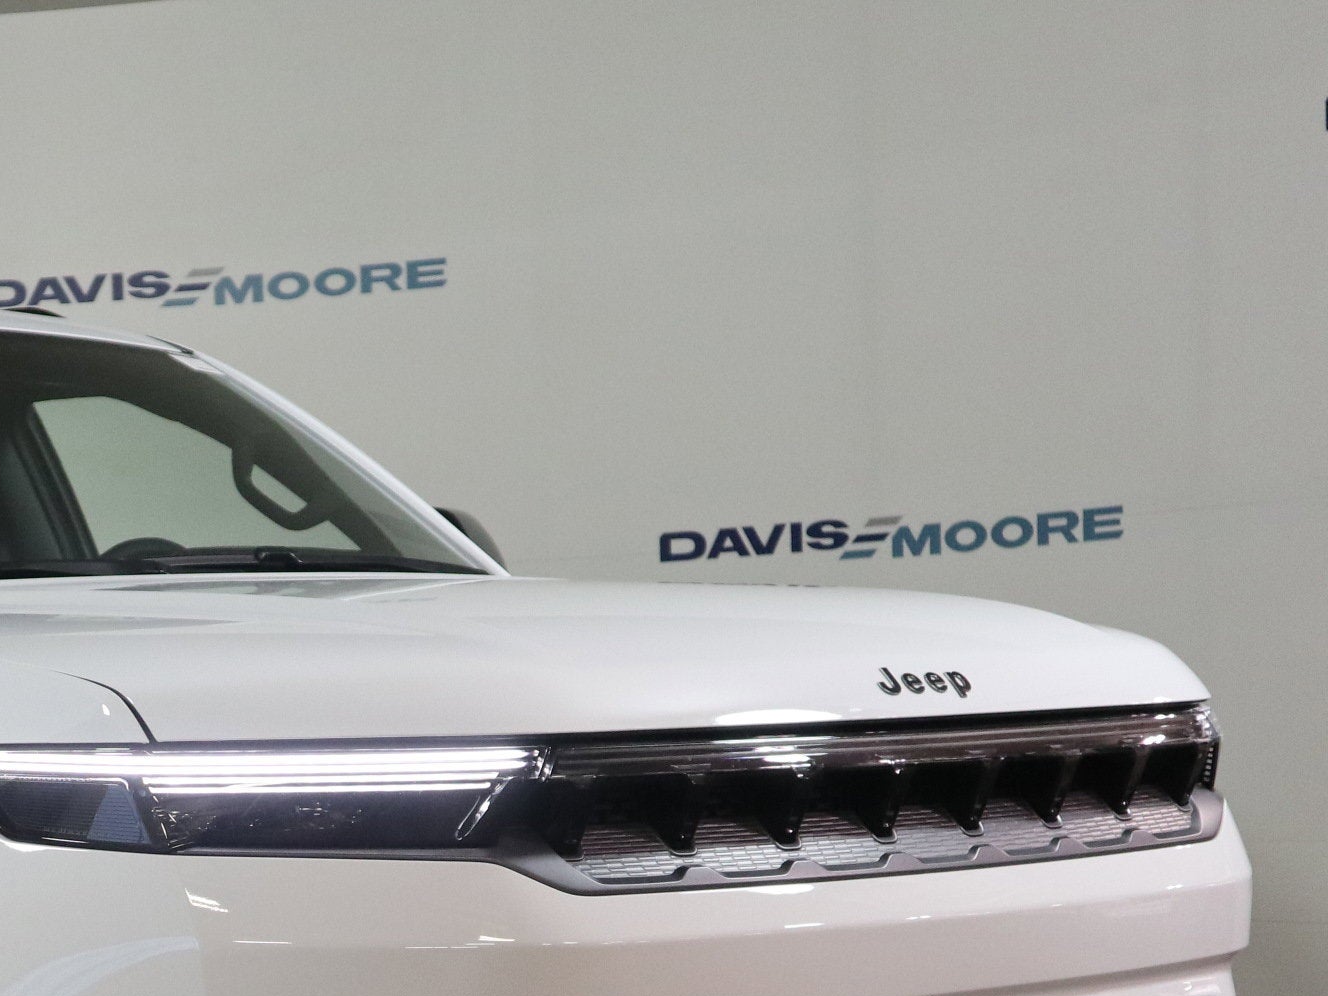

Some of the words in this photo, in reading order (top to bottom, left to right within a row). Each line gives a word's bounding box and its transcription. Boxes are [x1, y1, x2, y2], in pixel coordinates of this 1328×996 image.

[208, 257, 447, 306] MOORE
[658, 518, 850, 563] DAVIS
[890, 505, 1124, 558] MOORE
[877, 667, 972, 699] Jeep
